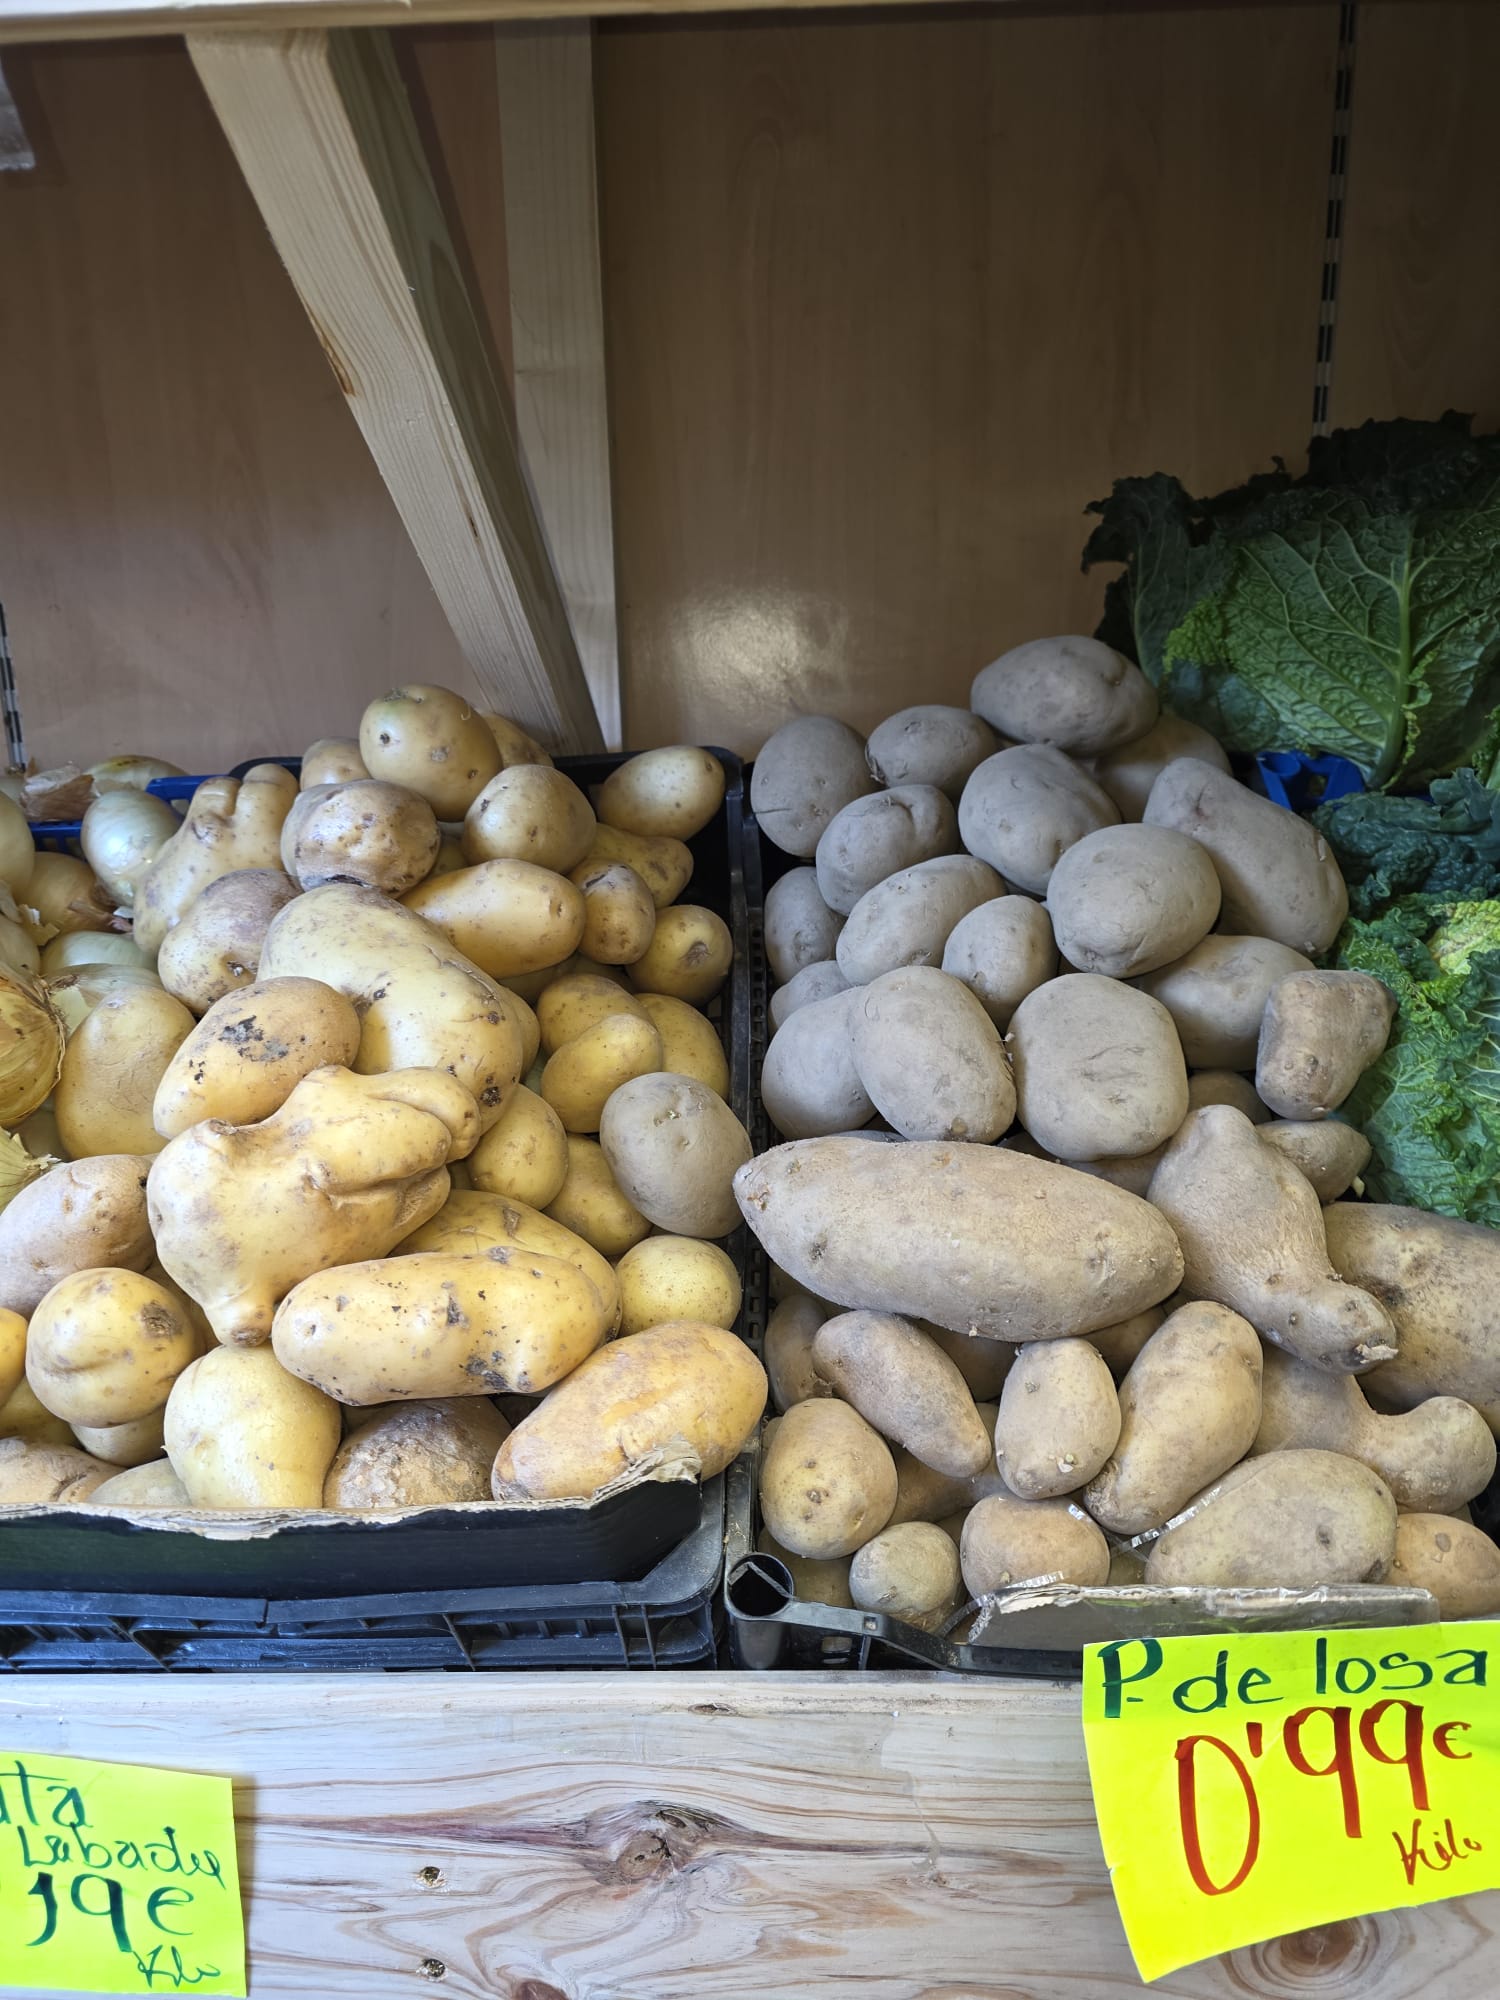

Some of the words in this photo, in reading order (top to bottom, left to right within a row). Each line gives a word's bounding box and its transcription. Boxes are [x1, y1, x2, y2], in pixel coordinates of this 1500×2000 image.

[1172, 1650, 1284, 1713] de
[1315, 1637, 1488, 1695] losa
[1391, 1818, 1483, 1885] Kilo
